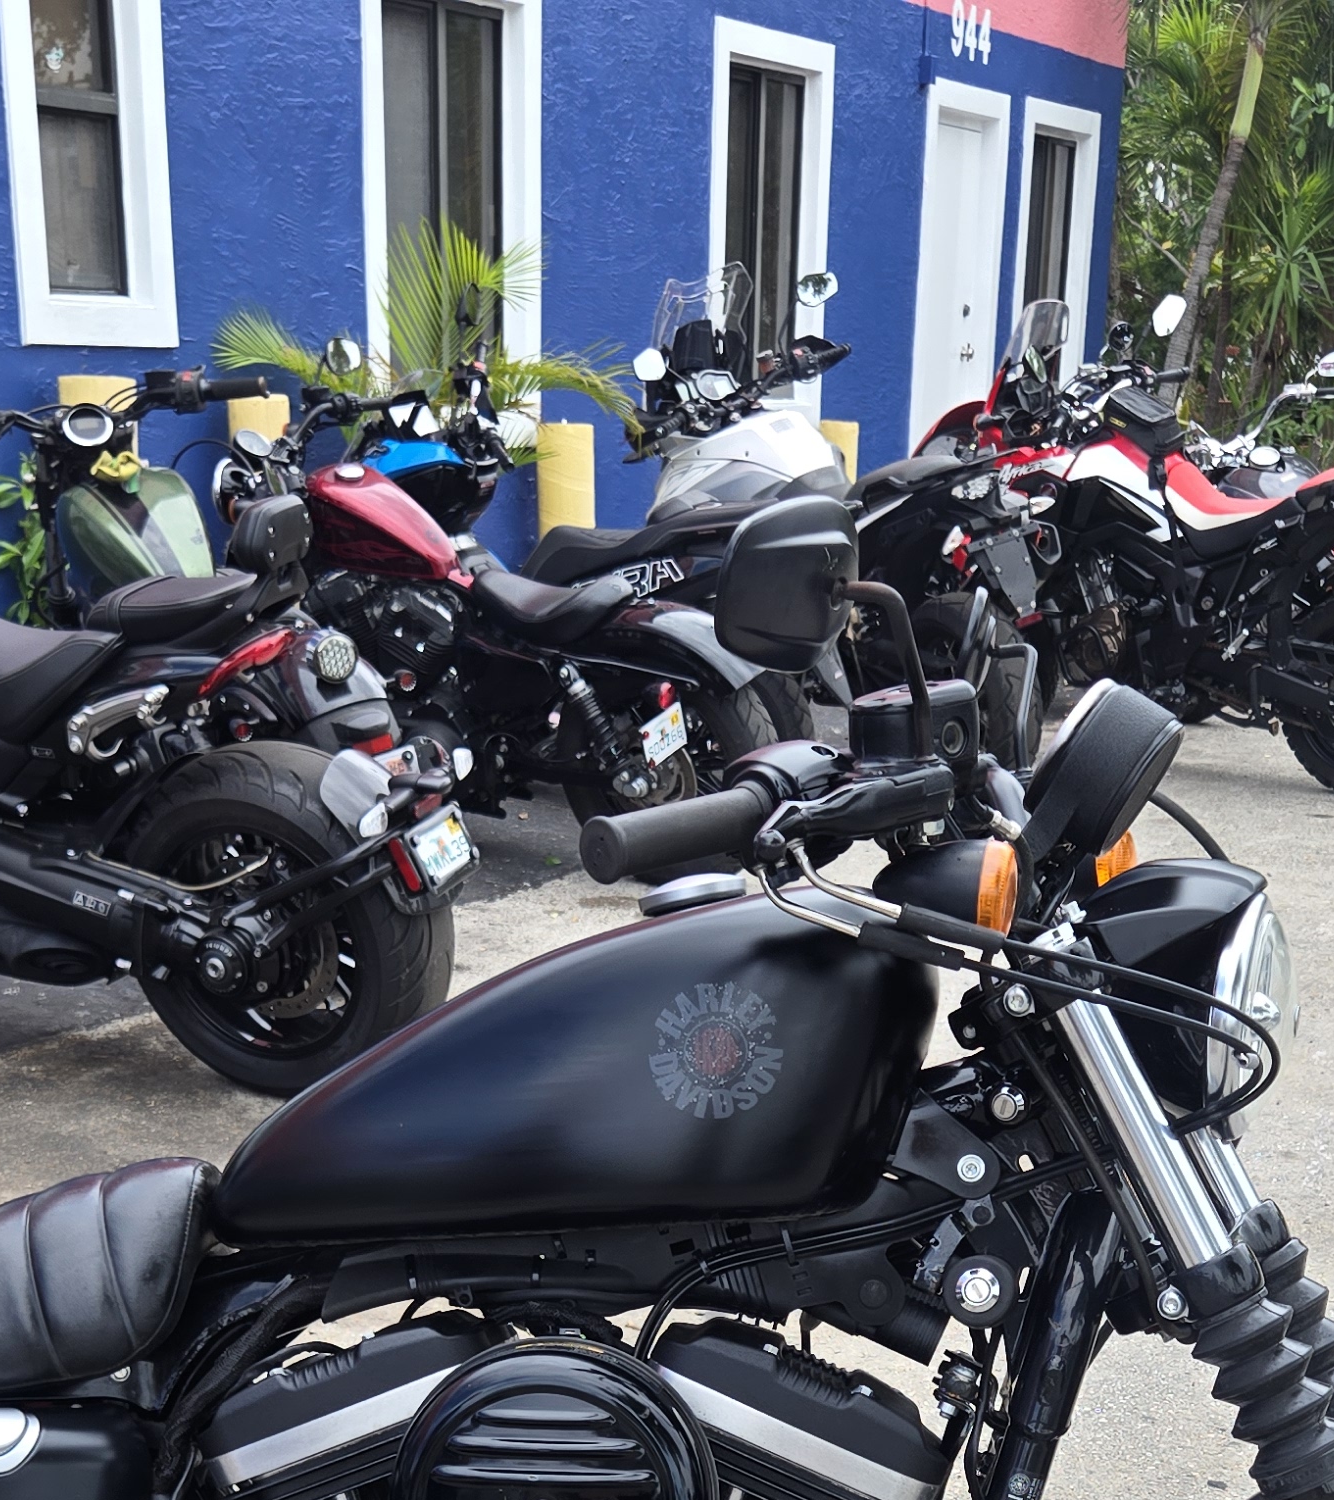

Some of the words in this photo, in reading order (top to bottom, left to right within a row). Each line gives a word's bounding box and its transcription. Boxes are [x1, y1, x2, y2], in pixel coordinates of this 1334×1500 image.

[951, 0, 991, 65] 944
[655, 981, 777, 1040] HARLEY
[649, 1046, 784, 1119] DAVIDSON
